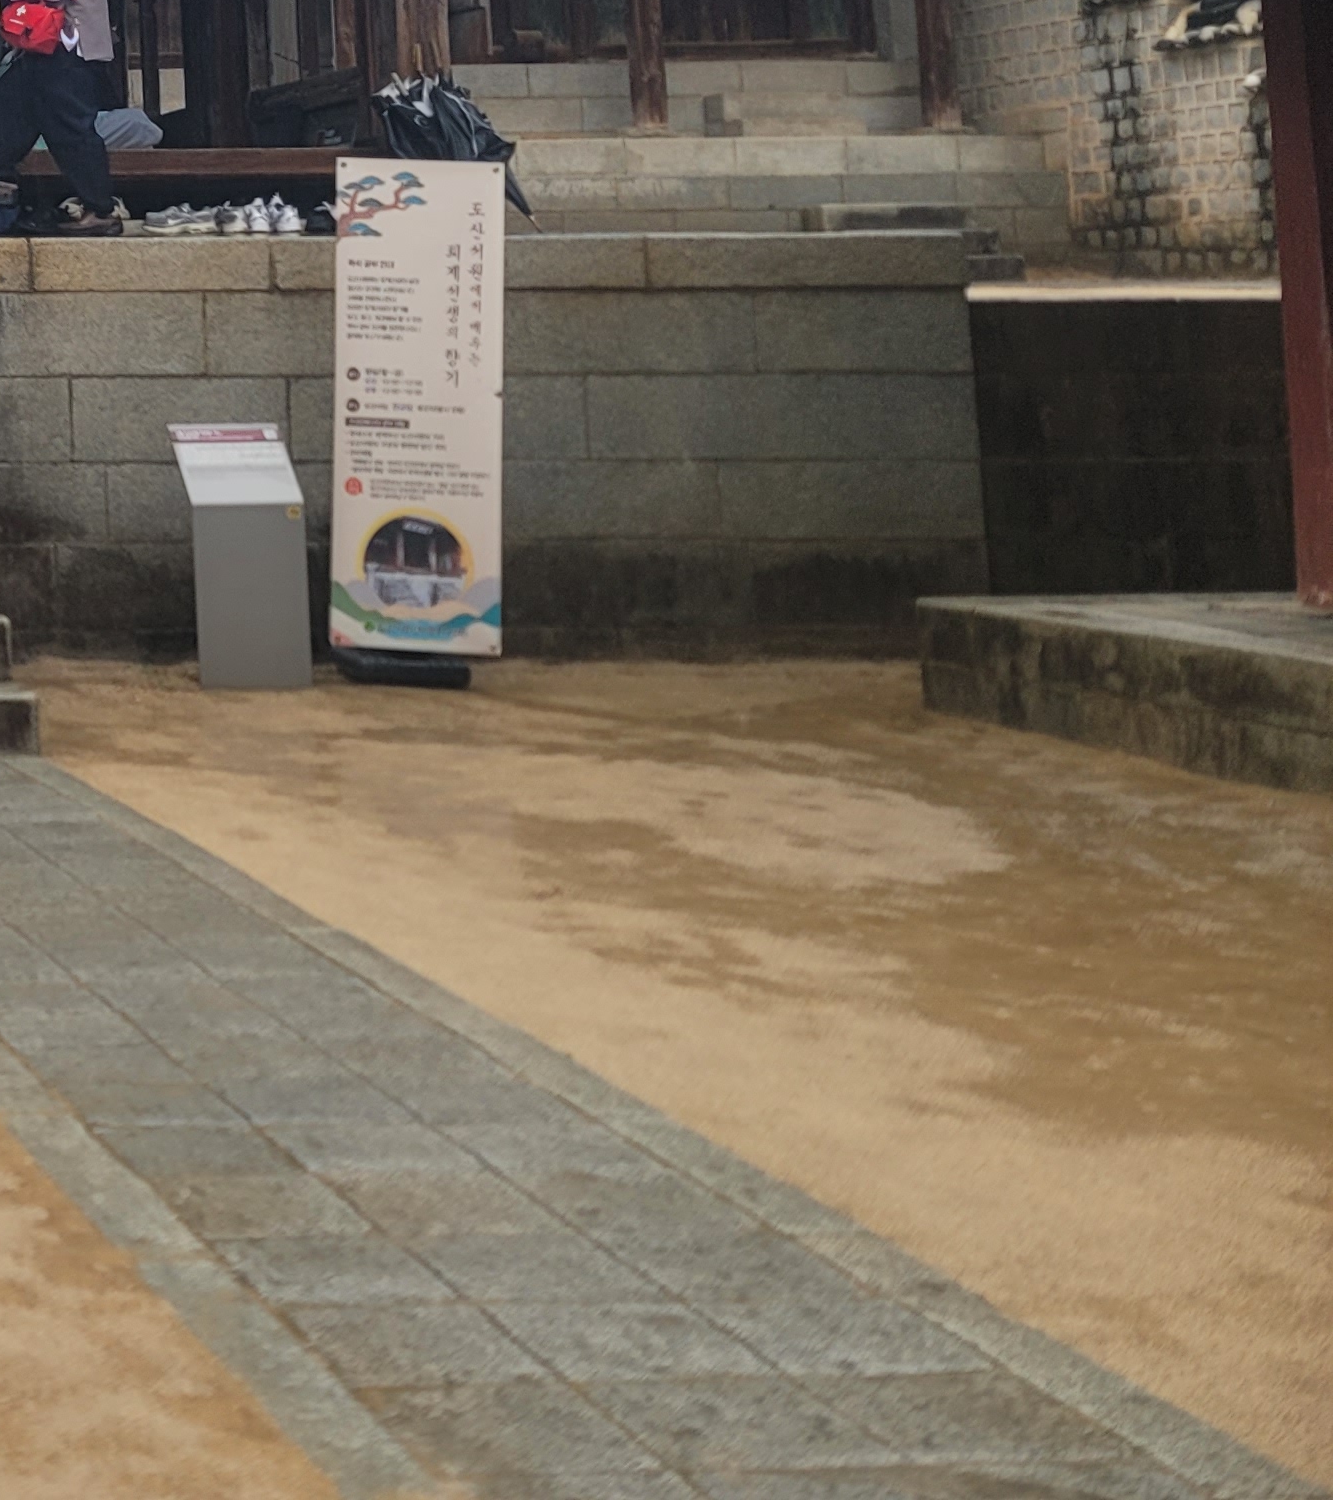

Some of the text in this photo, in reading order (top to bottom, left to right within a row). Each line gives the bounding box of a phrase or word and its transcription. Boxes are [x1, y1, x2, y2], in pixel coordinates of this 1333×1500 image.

[445, 244, 461, 388] 퇴계선생의 향기
[467, 202, 485, 313] 도산서원에서
